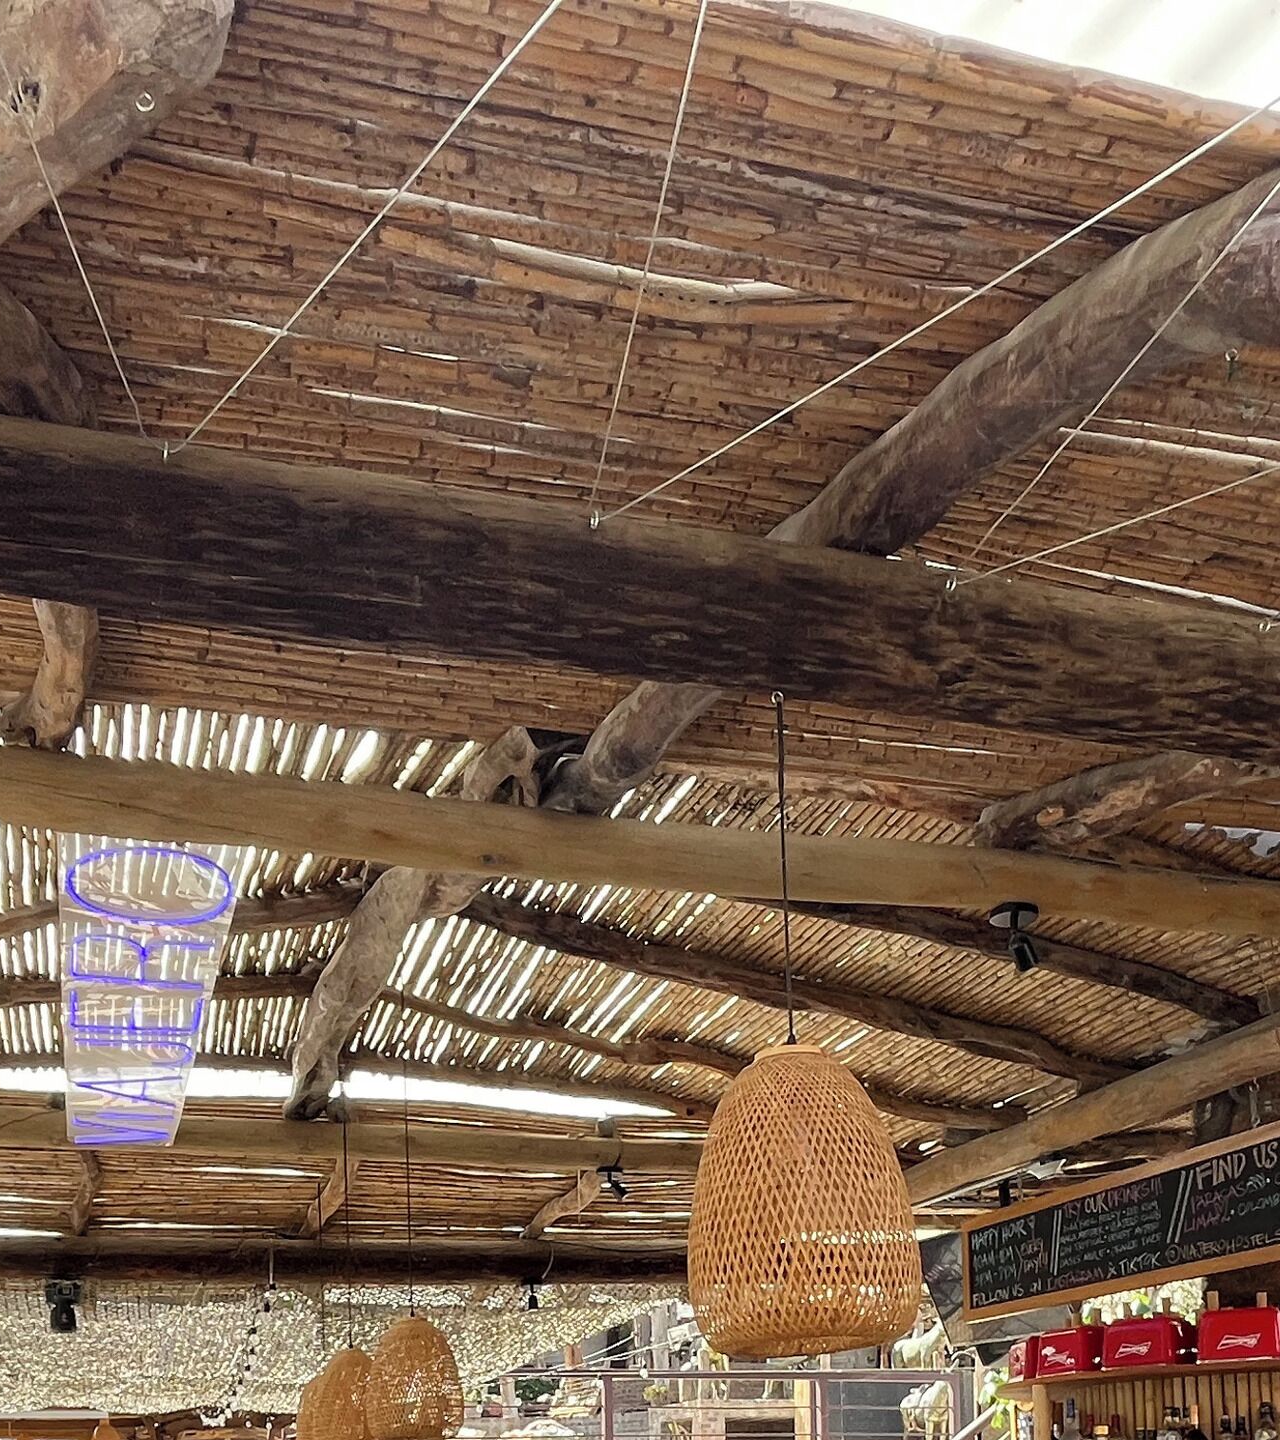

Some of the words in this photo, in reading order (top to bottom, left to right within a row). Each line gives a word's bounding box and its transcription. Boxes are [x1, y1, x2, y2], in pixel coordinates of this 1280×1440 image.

[1195, 1151, 1247, 1190] FIND
[1252, 1141, 1279, 1169] US
[1083, 1191, 1109, 1213] OUR
[971, 1225, 1000, 1251] HAPPY
[1001, 1219, 1028, 1245] HOUR
[972, 1285, 1010, 1307] FOLLOW
[1118, 1251, 1162, 1276] TIKTOK
